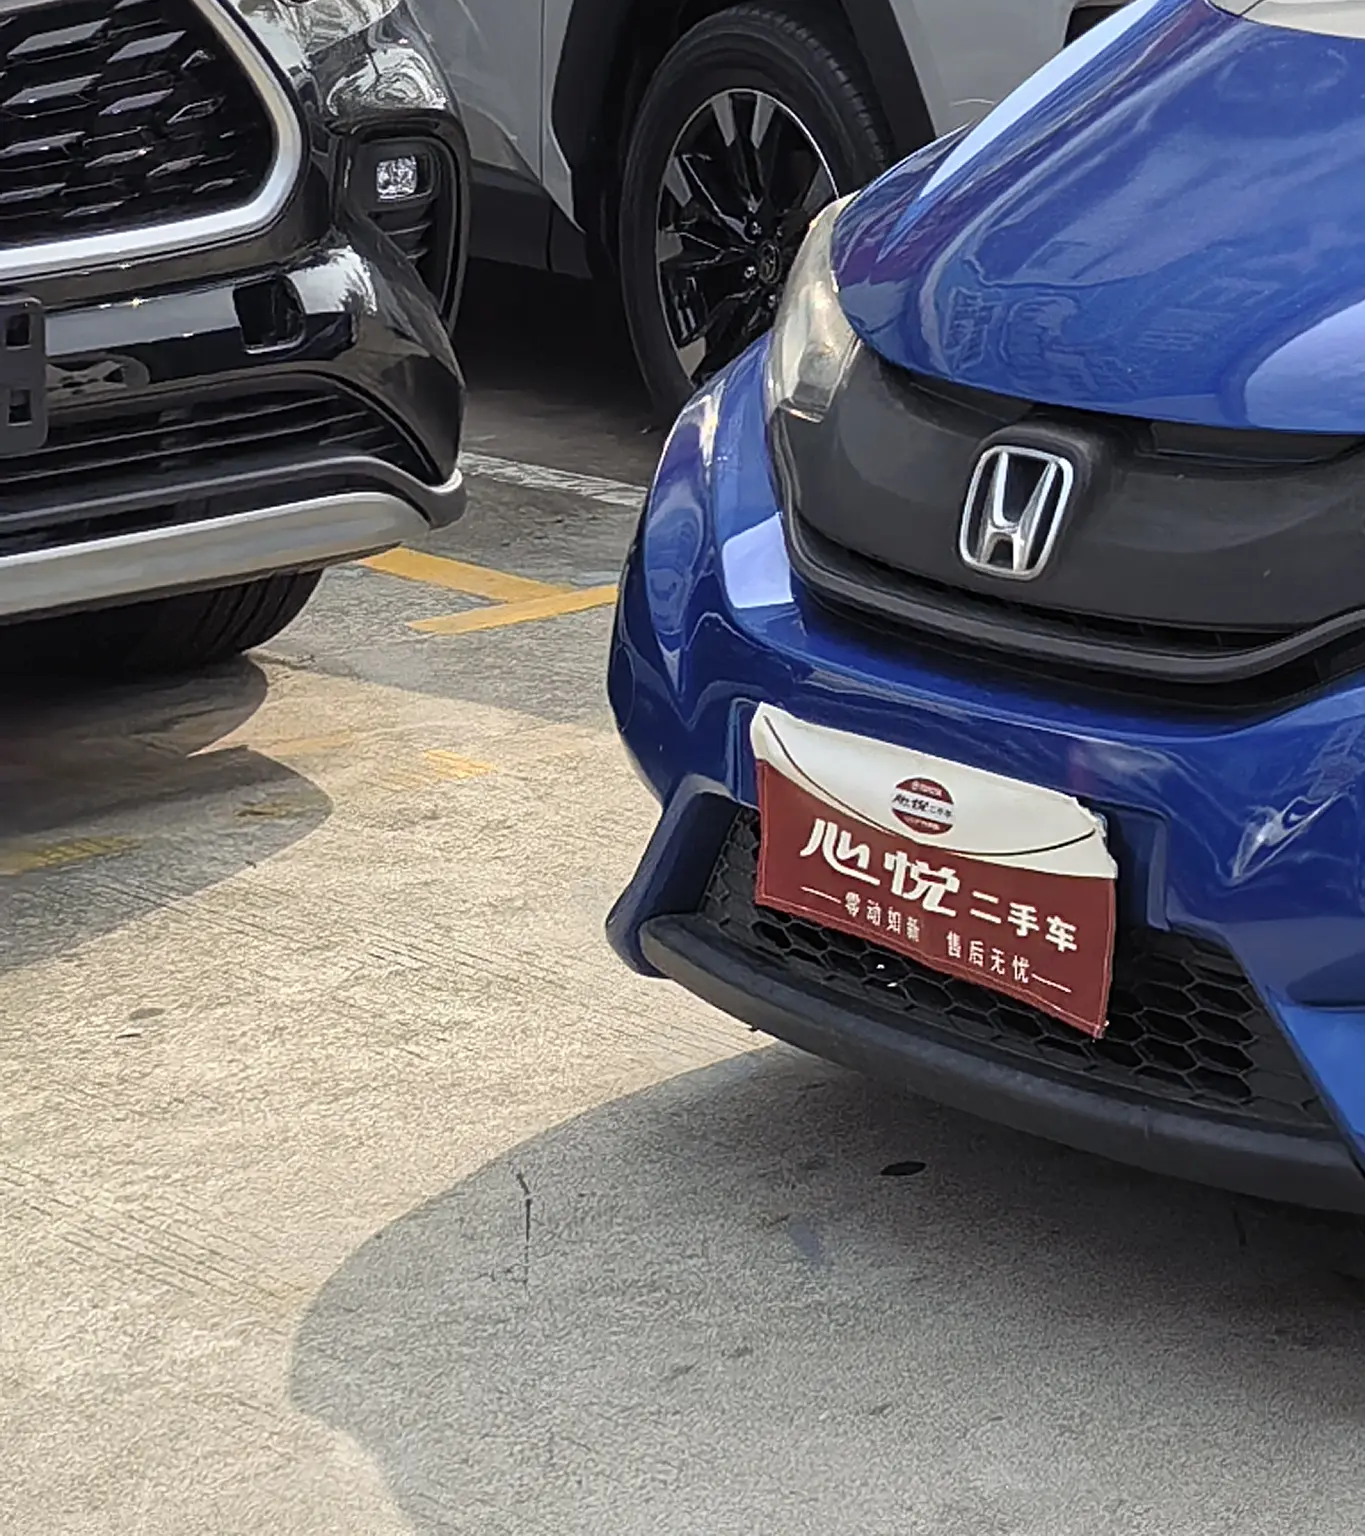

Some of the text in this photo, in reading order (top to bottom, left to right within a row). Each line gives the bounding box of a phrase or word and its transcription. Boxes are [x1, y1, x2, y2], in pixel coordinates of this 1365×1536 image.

[800, 817, 1079, 954] 心悦二手车
[945, 930, 1031, 985] 售后无忧
